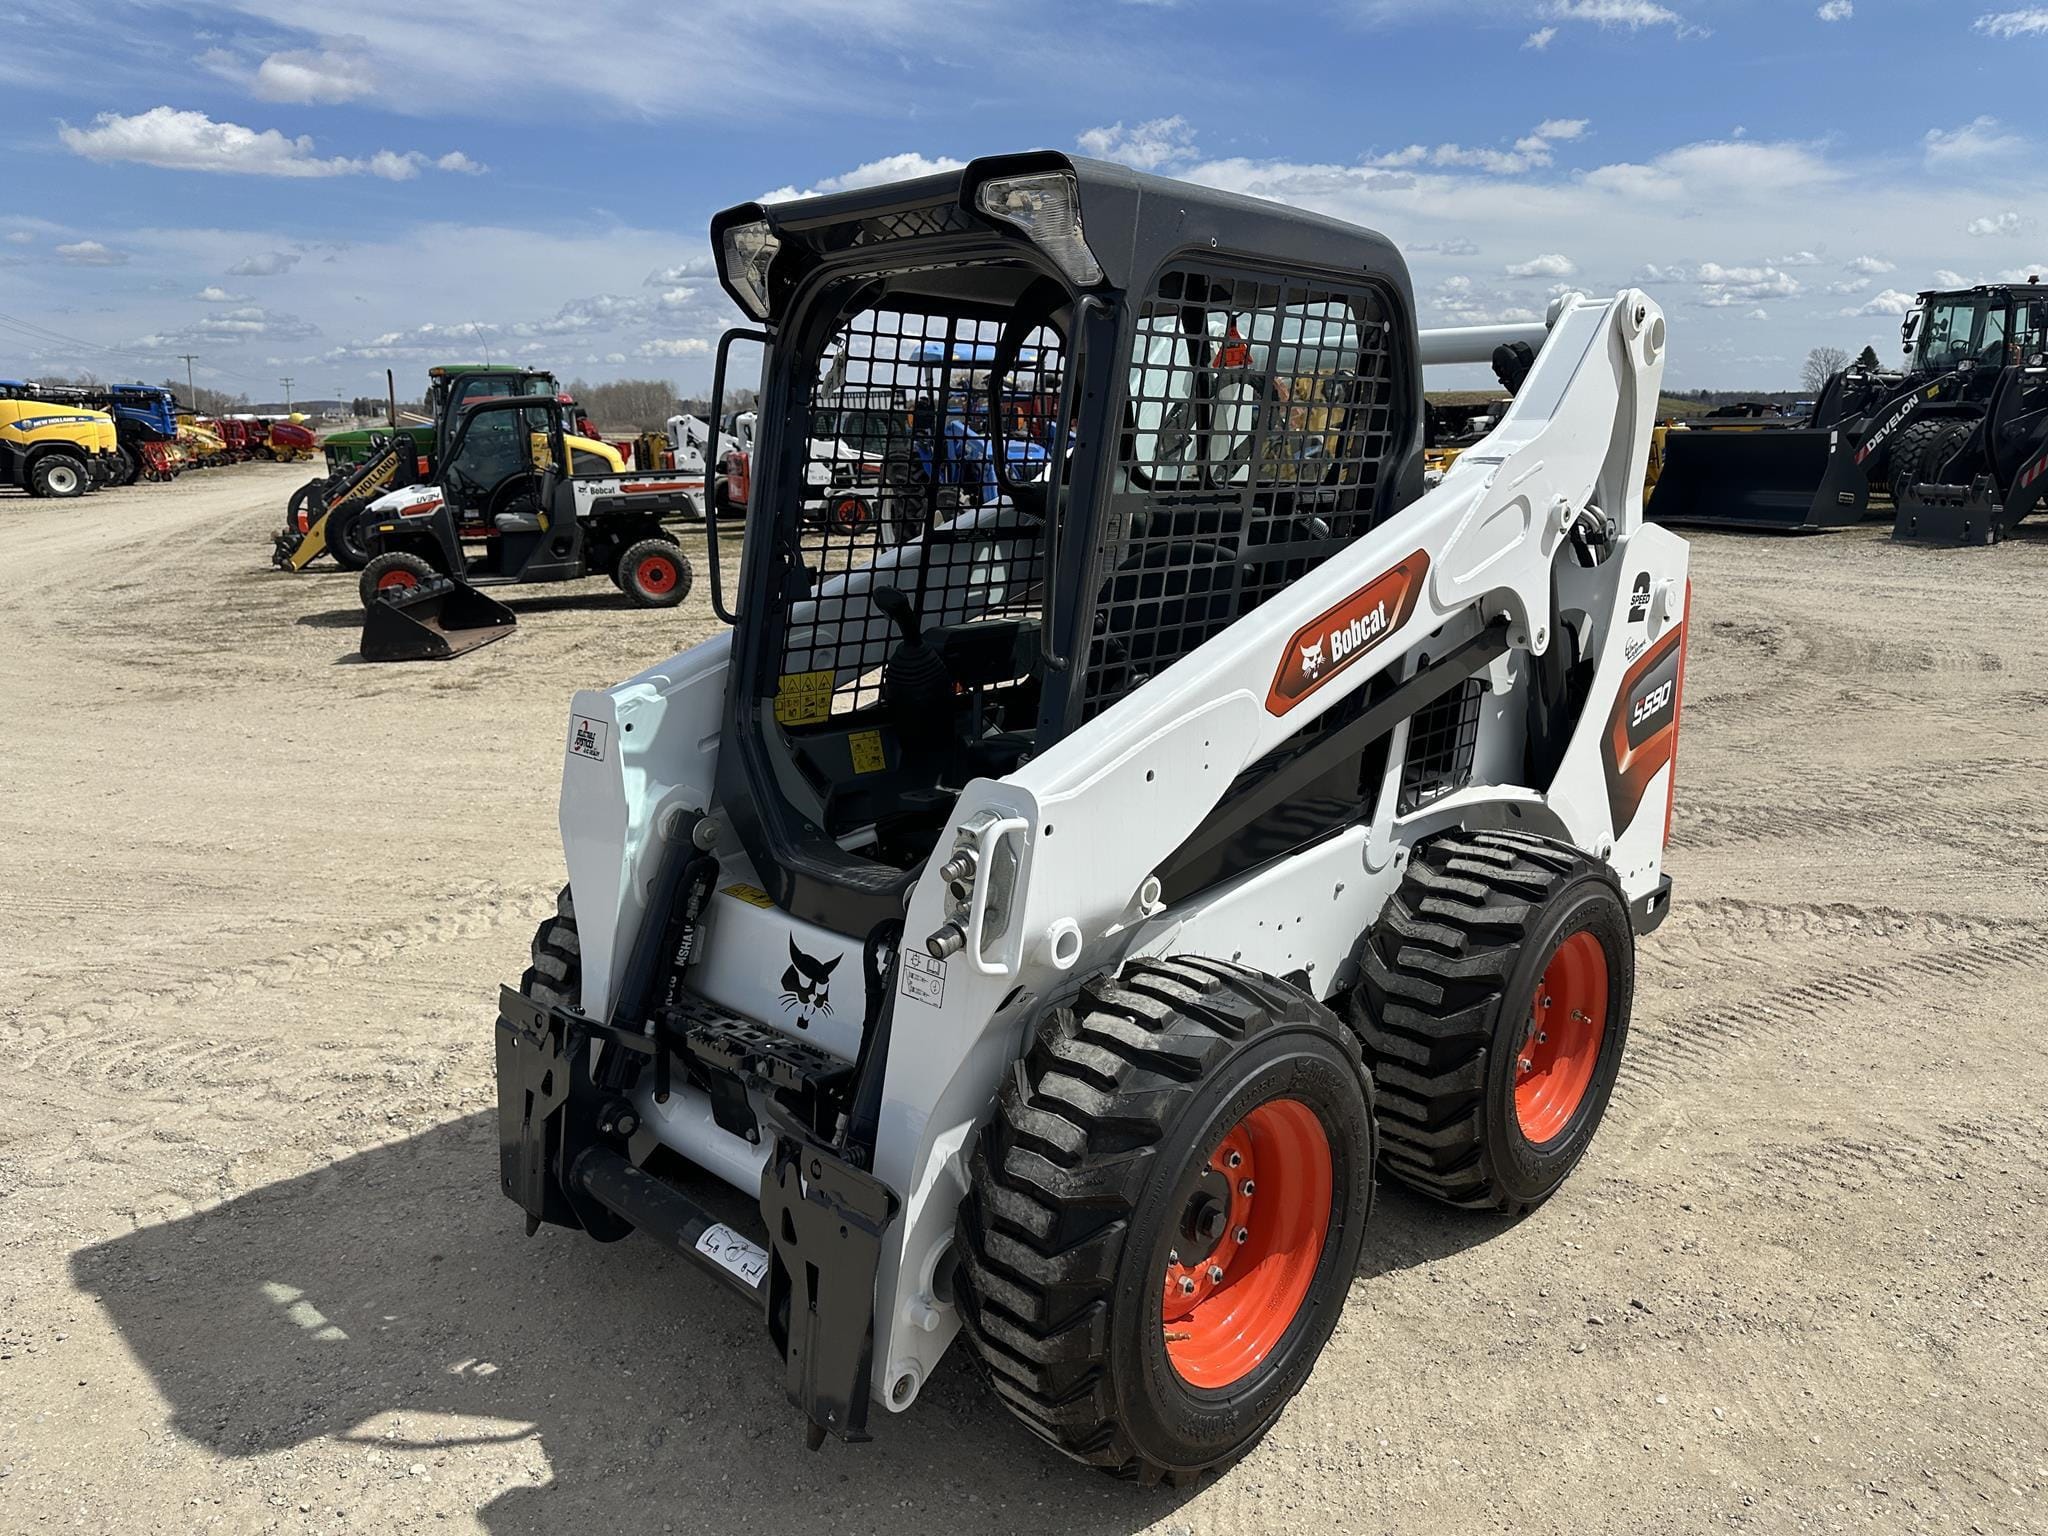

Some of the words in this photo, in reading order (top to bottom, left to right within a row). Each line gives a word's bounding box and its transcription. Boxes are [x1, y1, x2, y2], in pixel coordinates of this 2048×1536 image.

[33, 420, 48, 428] NEW
[1866, 393, 1919, 452] DEVELON
[357, 457, 397, 496] HOLLAND
[590, 486, 616, 495] Bobcat
[416, 493, 440, 504] UV34
[1628, 571, 1651, 622] 2
[1631, 594, 1651, 606] SPEED
[1330, 600, 1387, 663] Bobcat
[1632, 679, 1672, 728] S590
[674, 933, 694, 967] MSHA
